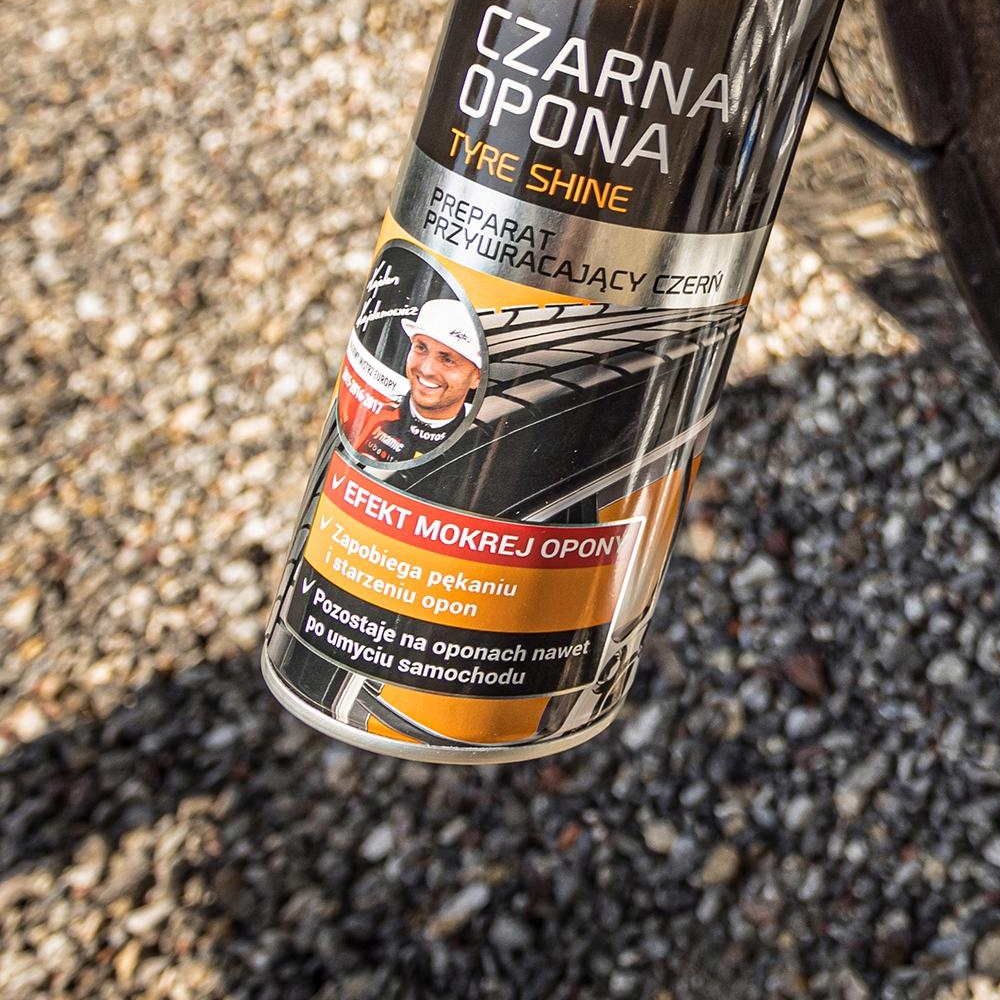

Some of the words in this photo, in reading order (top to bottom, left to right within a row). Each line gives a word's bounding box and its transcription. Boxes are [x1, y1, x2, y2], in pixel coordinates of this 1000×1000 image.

[476, 4, 730, 123] CZARNA
[458, 63, 669, 174] OPONA
[449, 127, 521, 183] TYRE
[526, 163, 634, 213] SHINE
[423, 209, 648, 293] PRZYWRACAJĄCY
[652, 270, 724, 296] CZERŃ
[430, 187, 556, 250] PREPARAT
[344, 481, 412, 530] EFEKT
[414, 515, 535, 558] MOKREJ
[325, 547, 332, 564] i
[332, 556, 417, 604] starzeniu
[421, 594, 478, 617] opon
[331, 523, 422, 580] Zapobiega
[427, 567, 518, 597] pękaniu
[305, 615, 325, 637] po
[327, 627, 394, 668] umyciu
[399, 658, 526, 685] samochodu
[313, 589, 395, 643] Pozostaje
[400, 632, 427, 652] na
[432, 641, 527, 662] oponach
[532, 639, 590, 661] nawet
